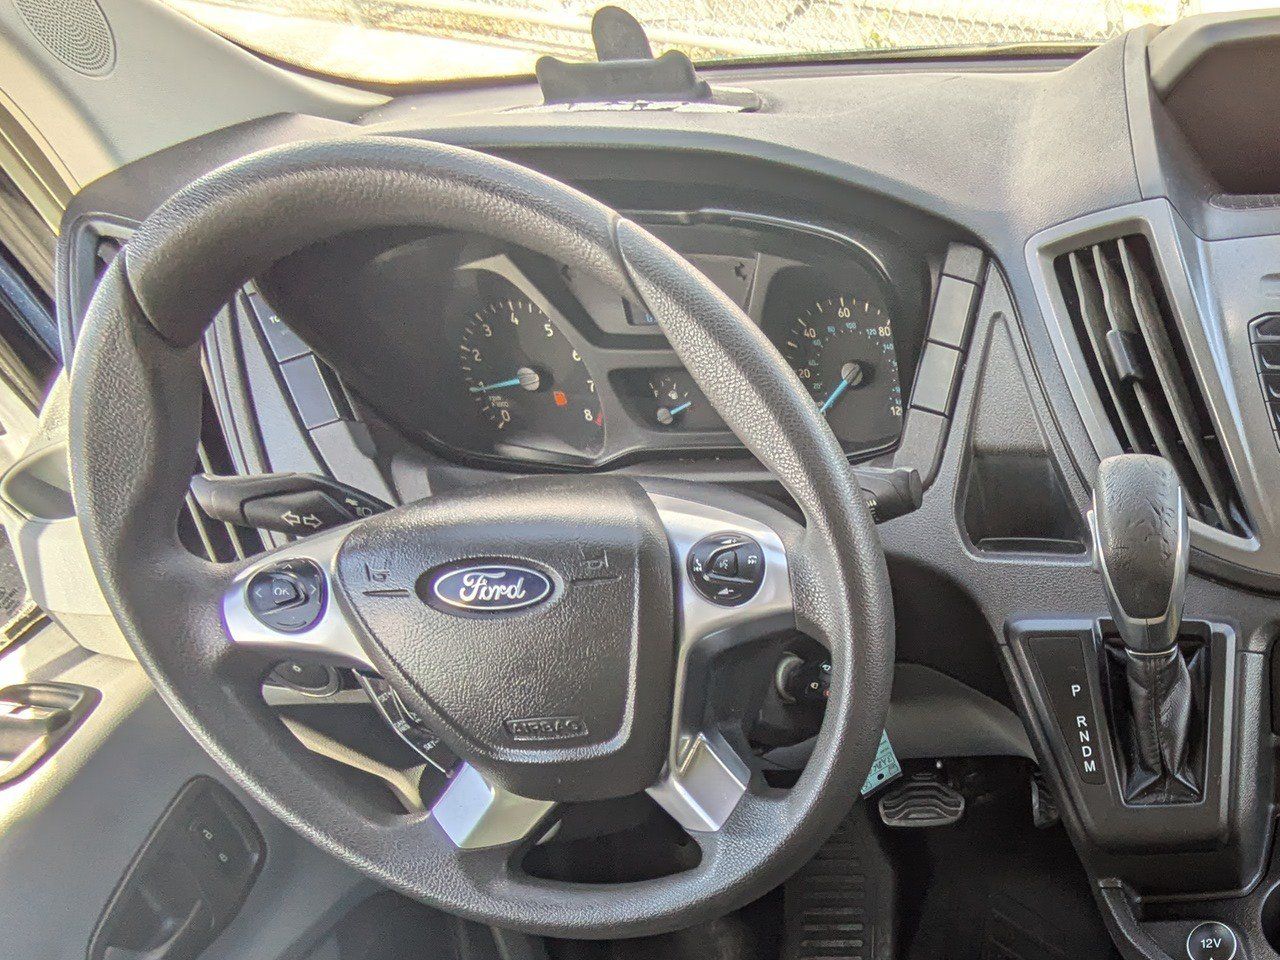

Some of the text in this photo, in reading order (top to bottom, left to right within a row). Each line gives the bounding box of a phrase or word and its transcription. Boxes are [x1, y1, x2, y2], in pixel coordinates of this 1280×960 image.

[838, 307, 850, 318] 60
[544, 323, 554, 337] 5
[878, 326, 892, 337] 80
[274, 587, 290, 596] OK
[459, 571, 526, 601] Ford
[1071, 685, 1081, 697] P
[1077, 716, 1087, 727] R
[1080, 731, 1090, 743] N
[1082, 746, 1092, 757] D
[1084, 760, 1096, 773] M
[1200, 938, 1222, 948] 12V
